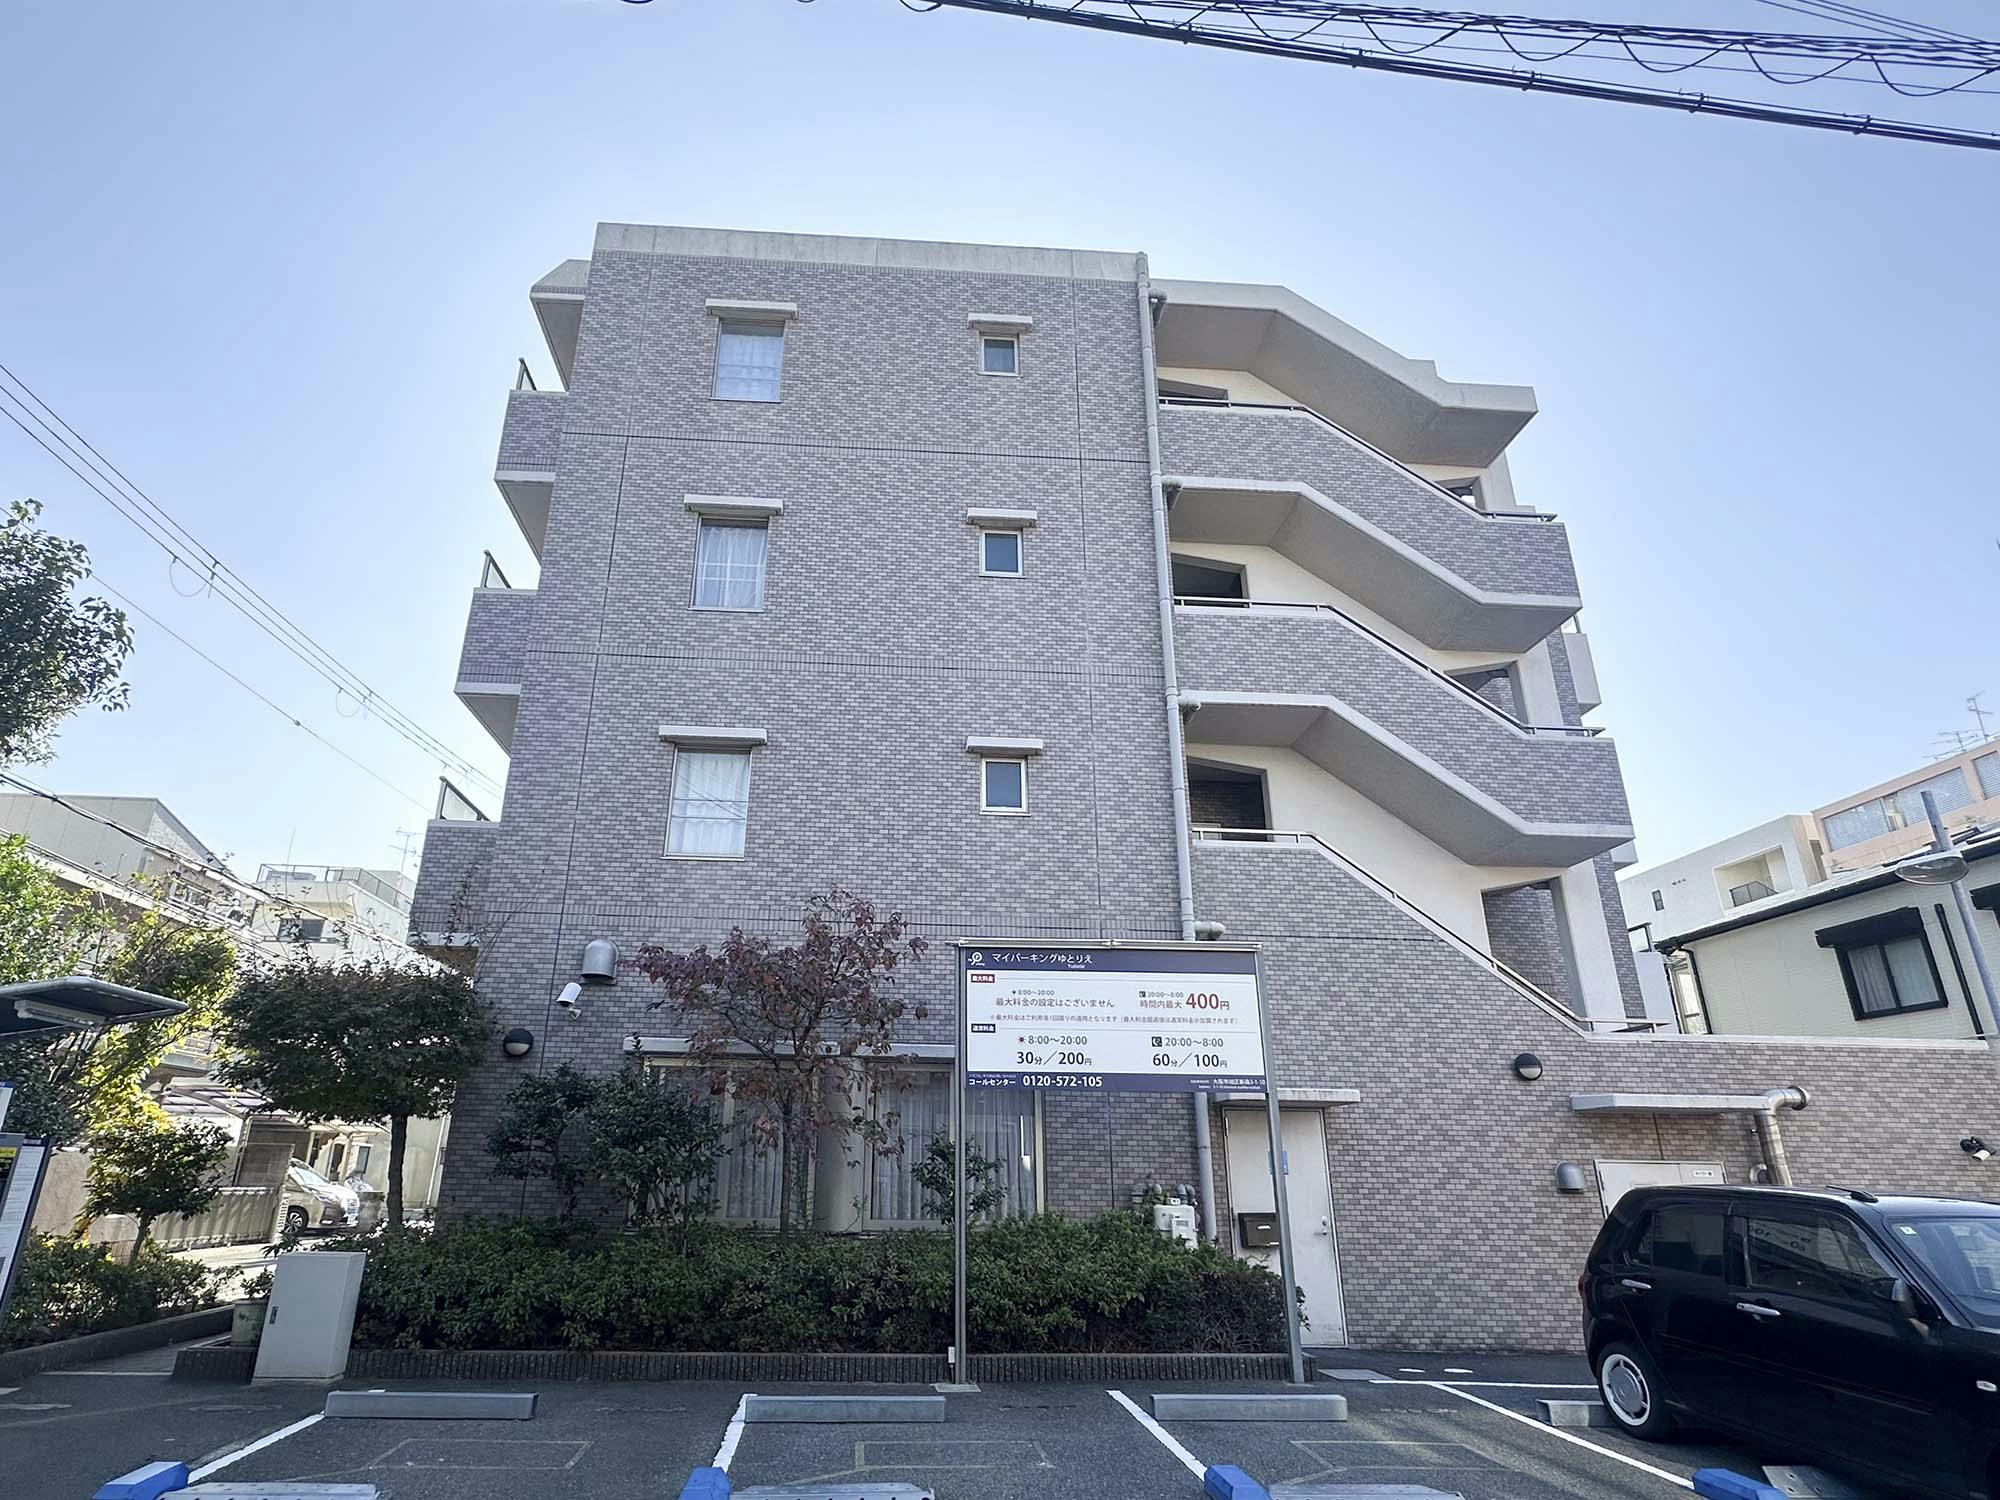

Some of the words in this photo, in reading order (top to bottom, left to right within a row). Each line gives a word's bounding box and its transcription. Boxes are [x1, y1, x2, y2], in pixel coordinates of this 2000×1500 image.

[996, 998, 1114, 1007] 最大料金の設定はございません
[1140, 1000, 1183, 1009] 時間内最大
[1186, 993, 1230, 1010] 400円
[1017, 1051, 1092, 1066] 30分／200円
[1152, 1052, 1228, 1068] 60分／100円
[969, 1078, 1016, 1086] コールセンター
[1022, 1075, 1102, 1087] 0120-572-105
